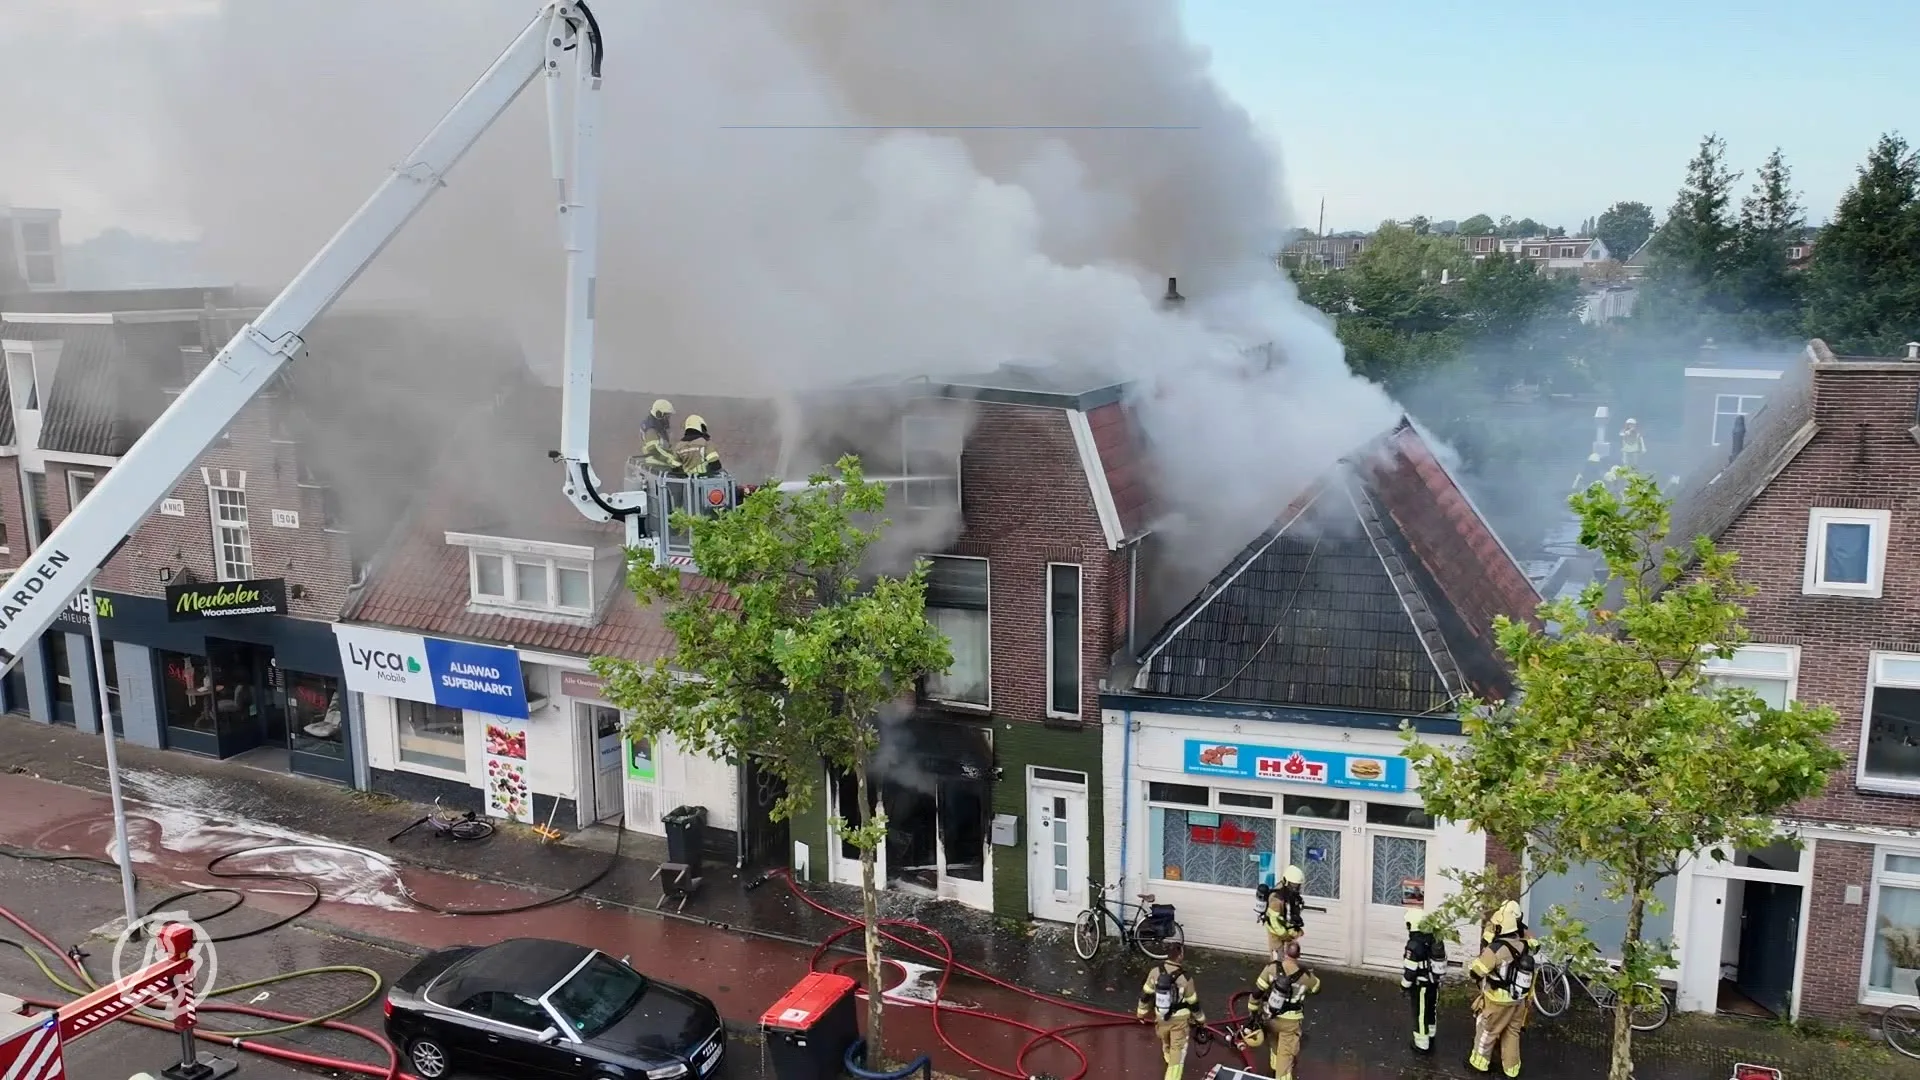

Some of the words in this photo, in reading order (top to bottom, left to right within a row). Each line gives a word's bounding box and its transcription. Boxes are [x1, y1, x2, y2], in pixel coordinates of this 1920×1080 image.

[176, 584, 259, 612] Meubelen
[201, 605, 276, 617] Woonaccessoires
[349, 642, 403, 671] Lyca
[377, 671, 406, 684] Mobile
[442, 675, 513, 696] SUPERMARKT
[1260, 755, 1323, 776] HOT
